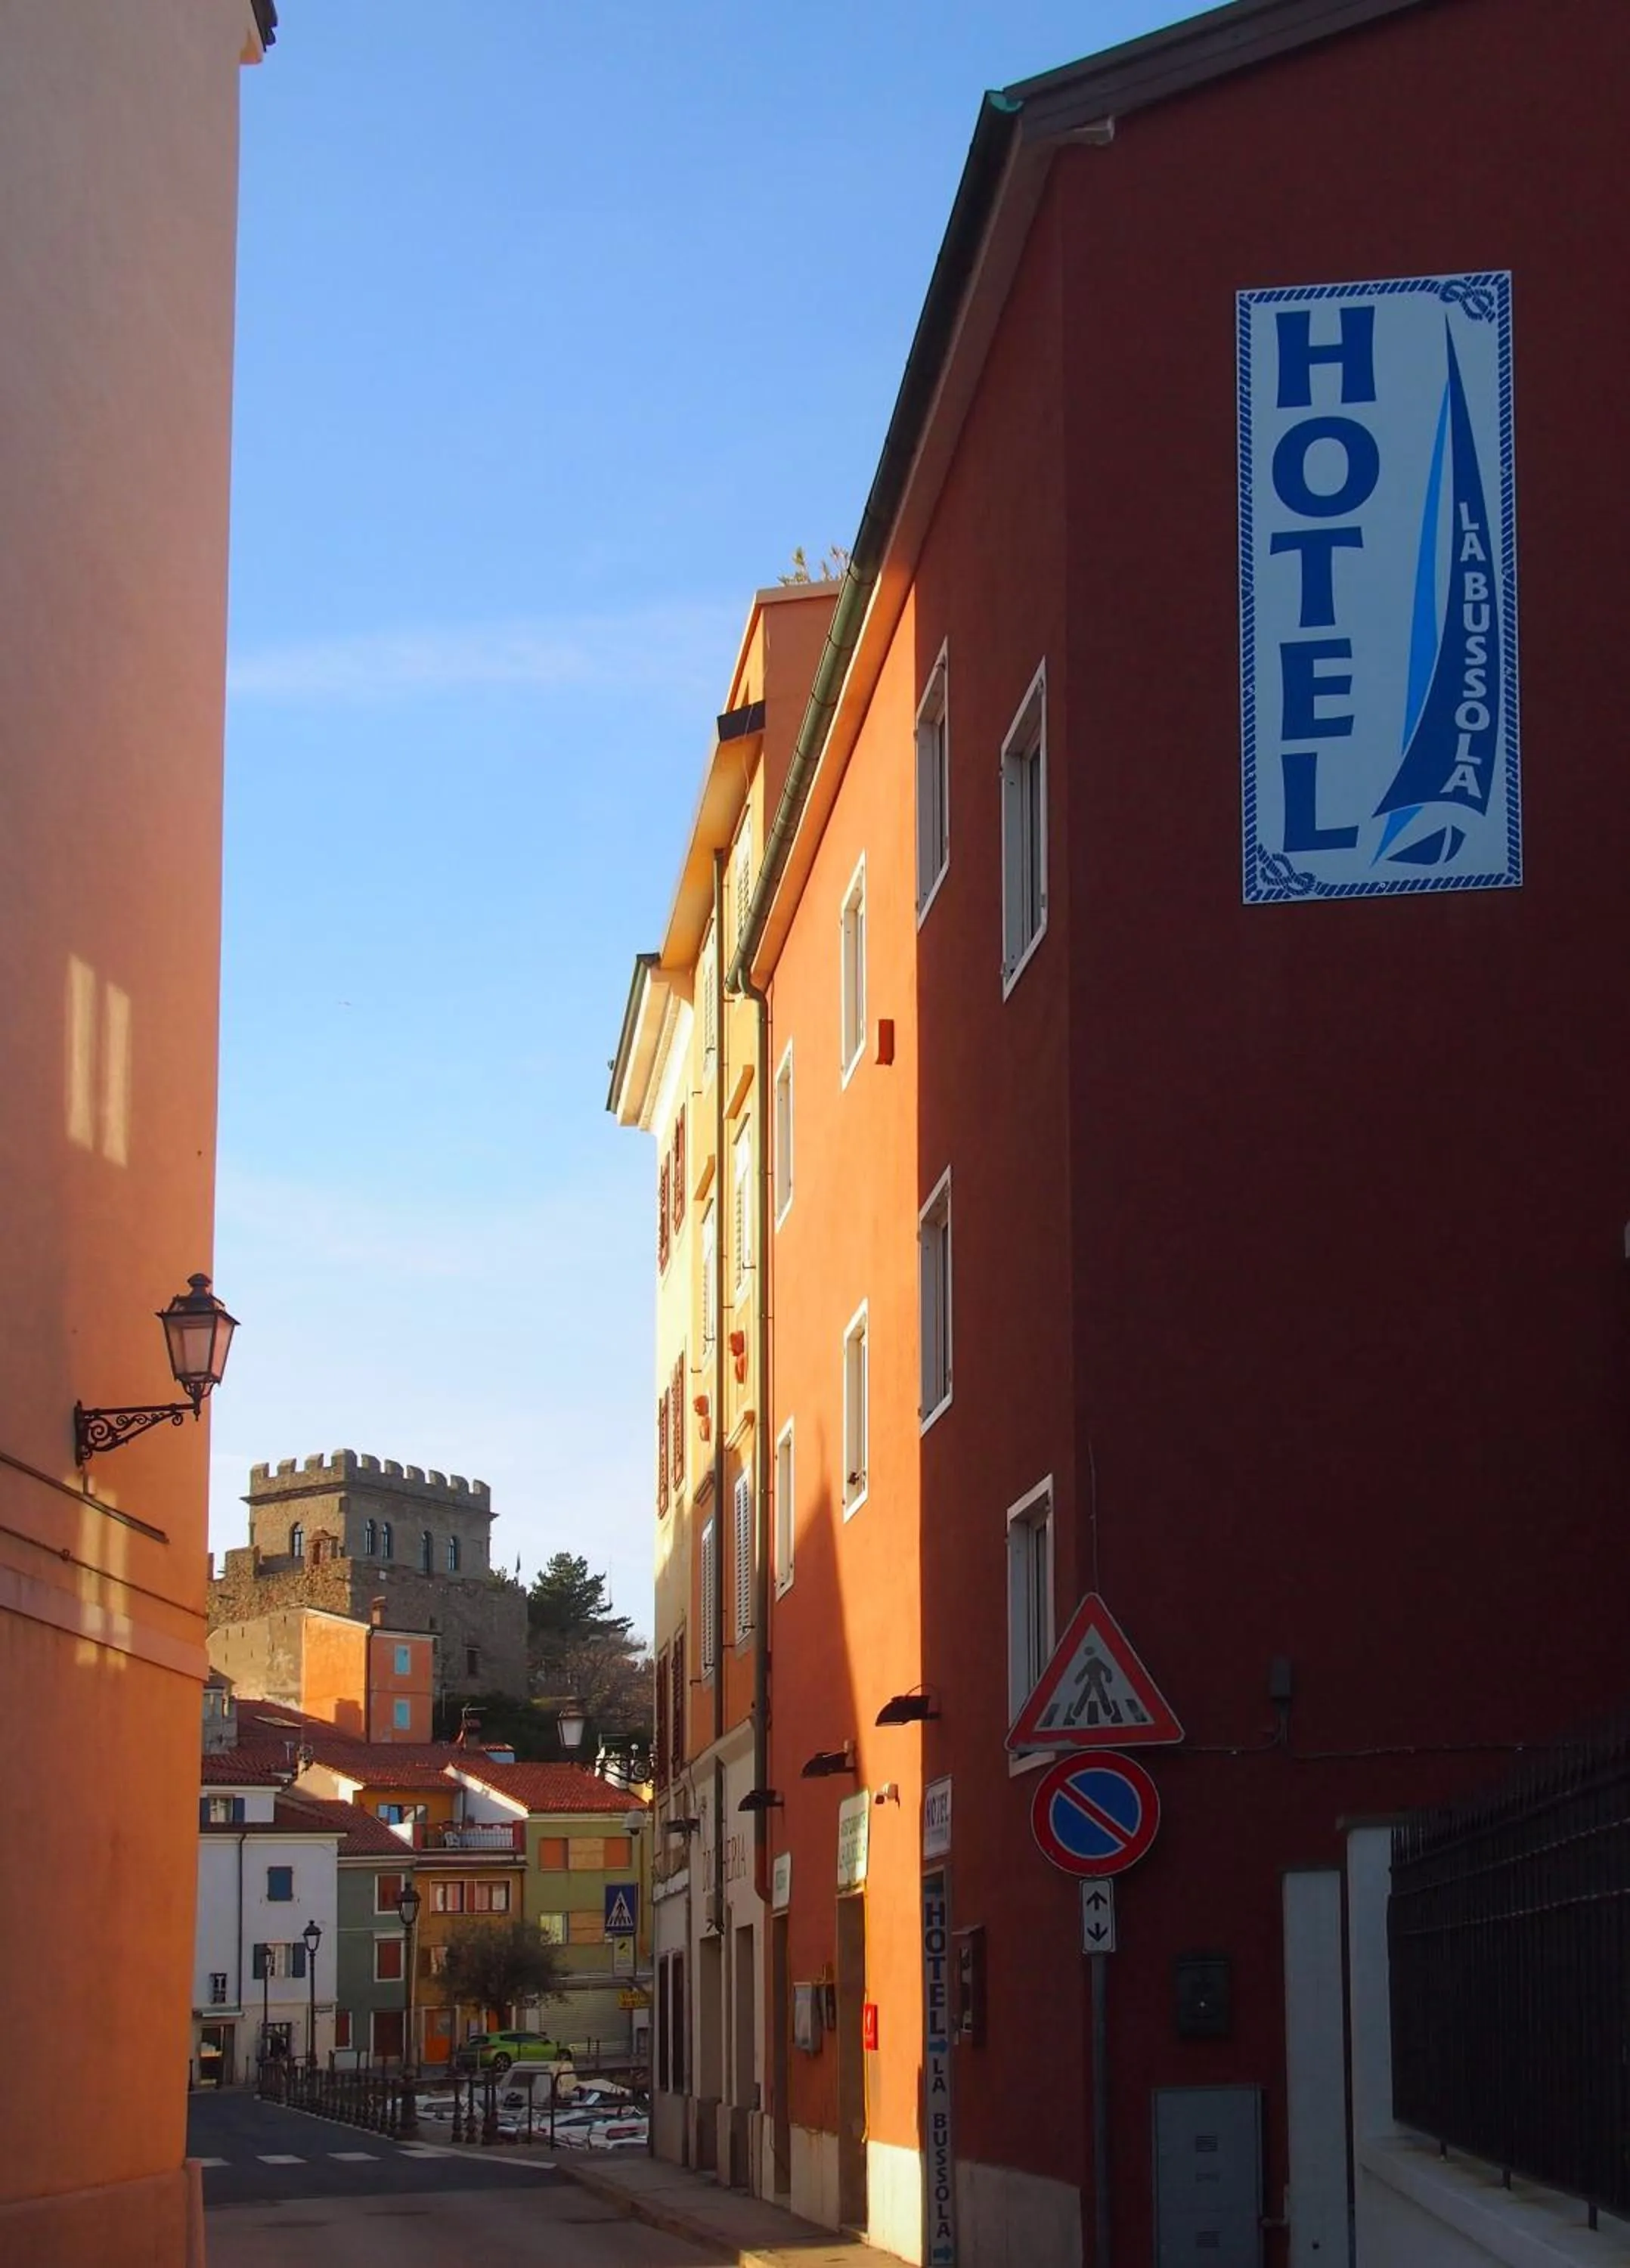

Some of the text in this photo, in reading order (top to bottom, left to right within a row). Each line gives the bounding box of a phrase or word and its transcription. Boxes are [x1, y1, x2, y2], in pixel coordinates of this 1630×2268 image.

[1269, 305, 1380, 853] HOTEL
[1439, 502, 1490, 799] LA BUSSOLA
[925, 1790, 949, 1827] HOTEL
[925, 1901, 946, 2034] HOTEL
[932, 2058, 950, 2239] LA BUSSOLA
